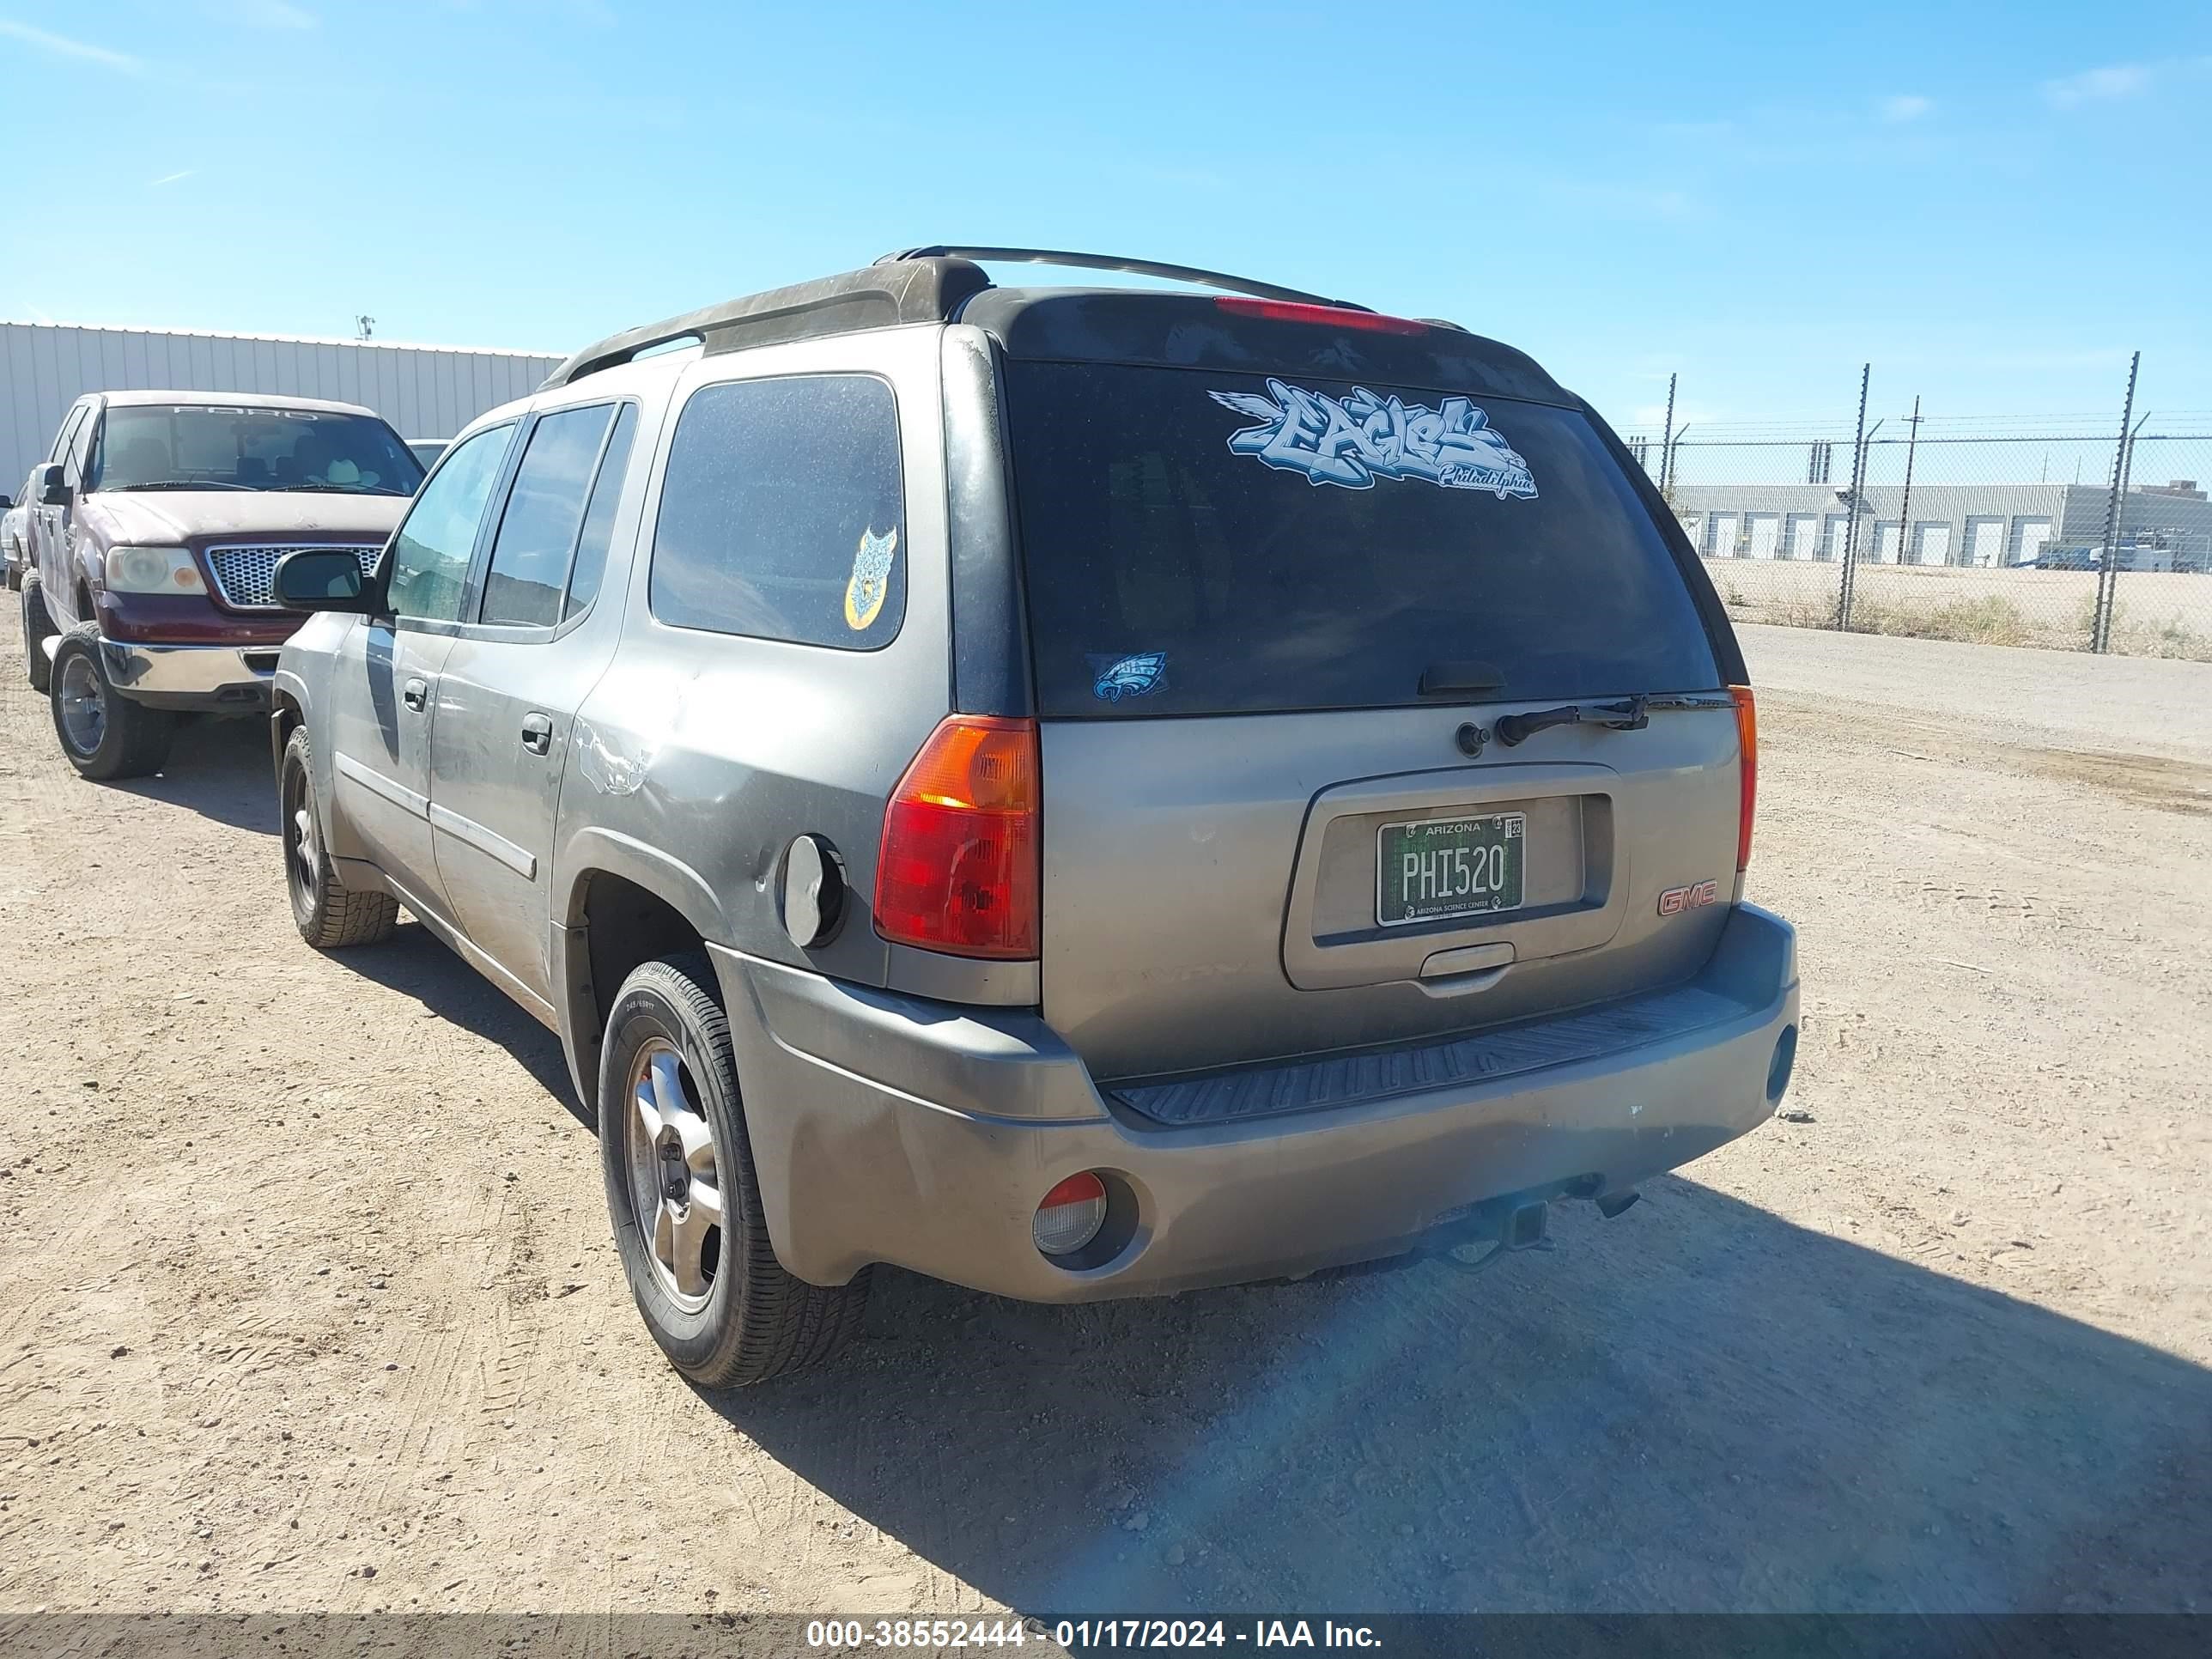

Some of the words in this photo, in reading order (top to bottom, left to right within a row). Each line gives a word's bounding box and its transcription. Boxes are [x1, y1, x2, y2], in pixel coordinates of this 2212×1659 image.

[1439, 463, 1534, 496] Philadelphia
[1425, 823, 1481, 836] ARIZONA
[1512, 823, 1521, 834] 23
[1403, 844, 1504, 902] PHI520
[1417, 906, 1443, 915] ARIZONA
[1443, 902, 1468, 911] SCIENCE
[1468, 900, 1489, 908] CENTER
[1657, 879, 1717, 916] GMC
